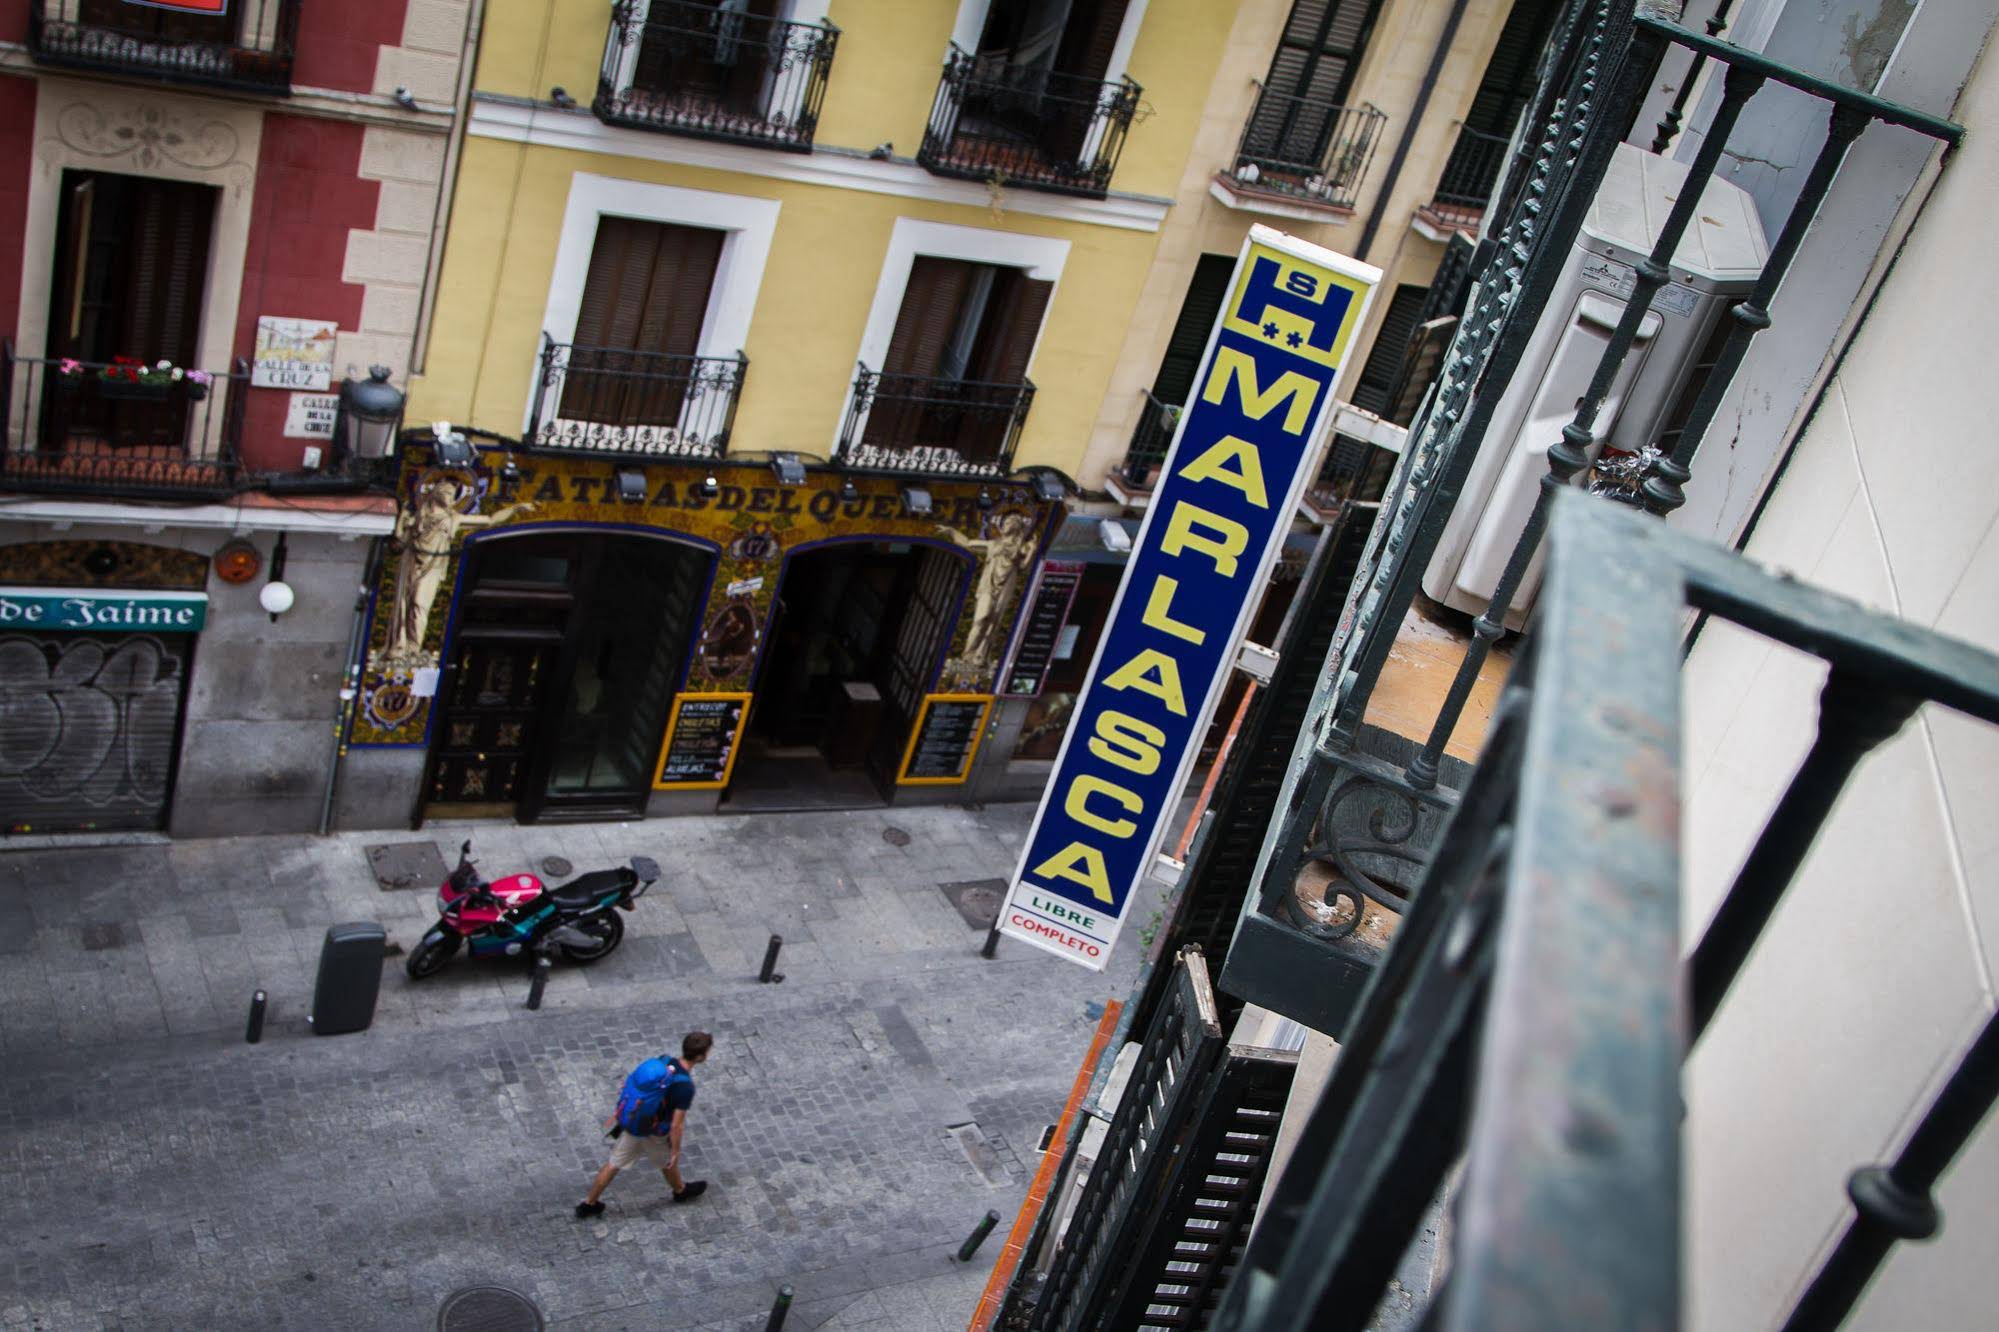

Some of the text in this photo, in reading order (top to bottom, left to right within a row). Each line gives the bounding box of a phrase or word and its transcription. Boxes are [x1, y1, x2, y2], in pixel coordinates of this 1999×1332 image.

[268, 373, 313, 386] CRUZ
[494, 469, 703, 511] FATIAS
[717, 481, 802, 515] DEL
[0, 598, 195, 627] de Jaime
[1032, 345, 1321, 905] MARLASCA
[1032, 896, 1096, 930] LIBRE
[1011, 914, 1100, 957] COMPLETO
